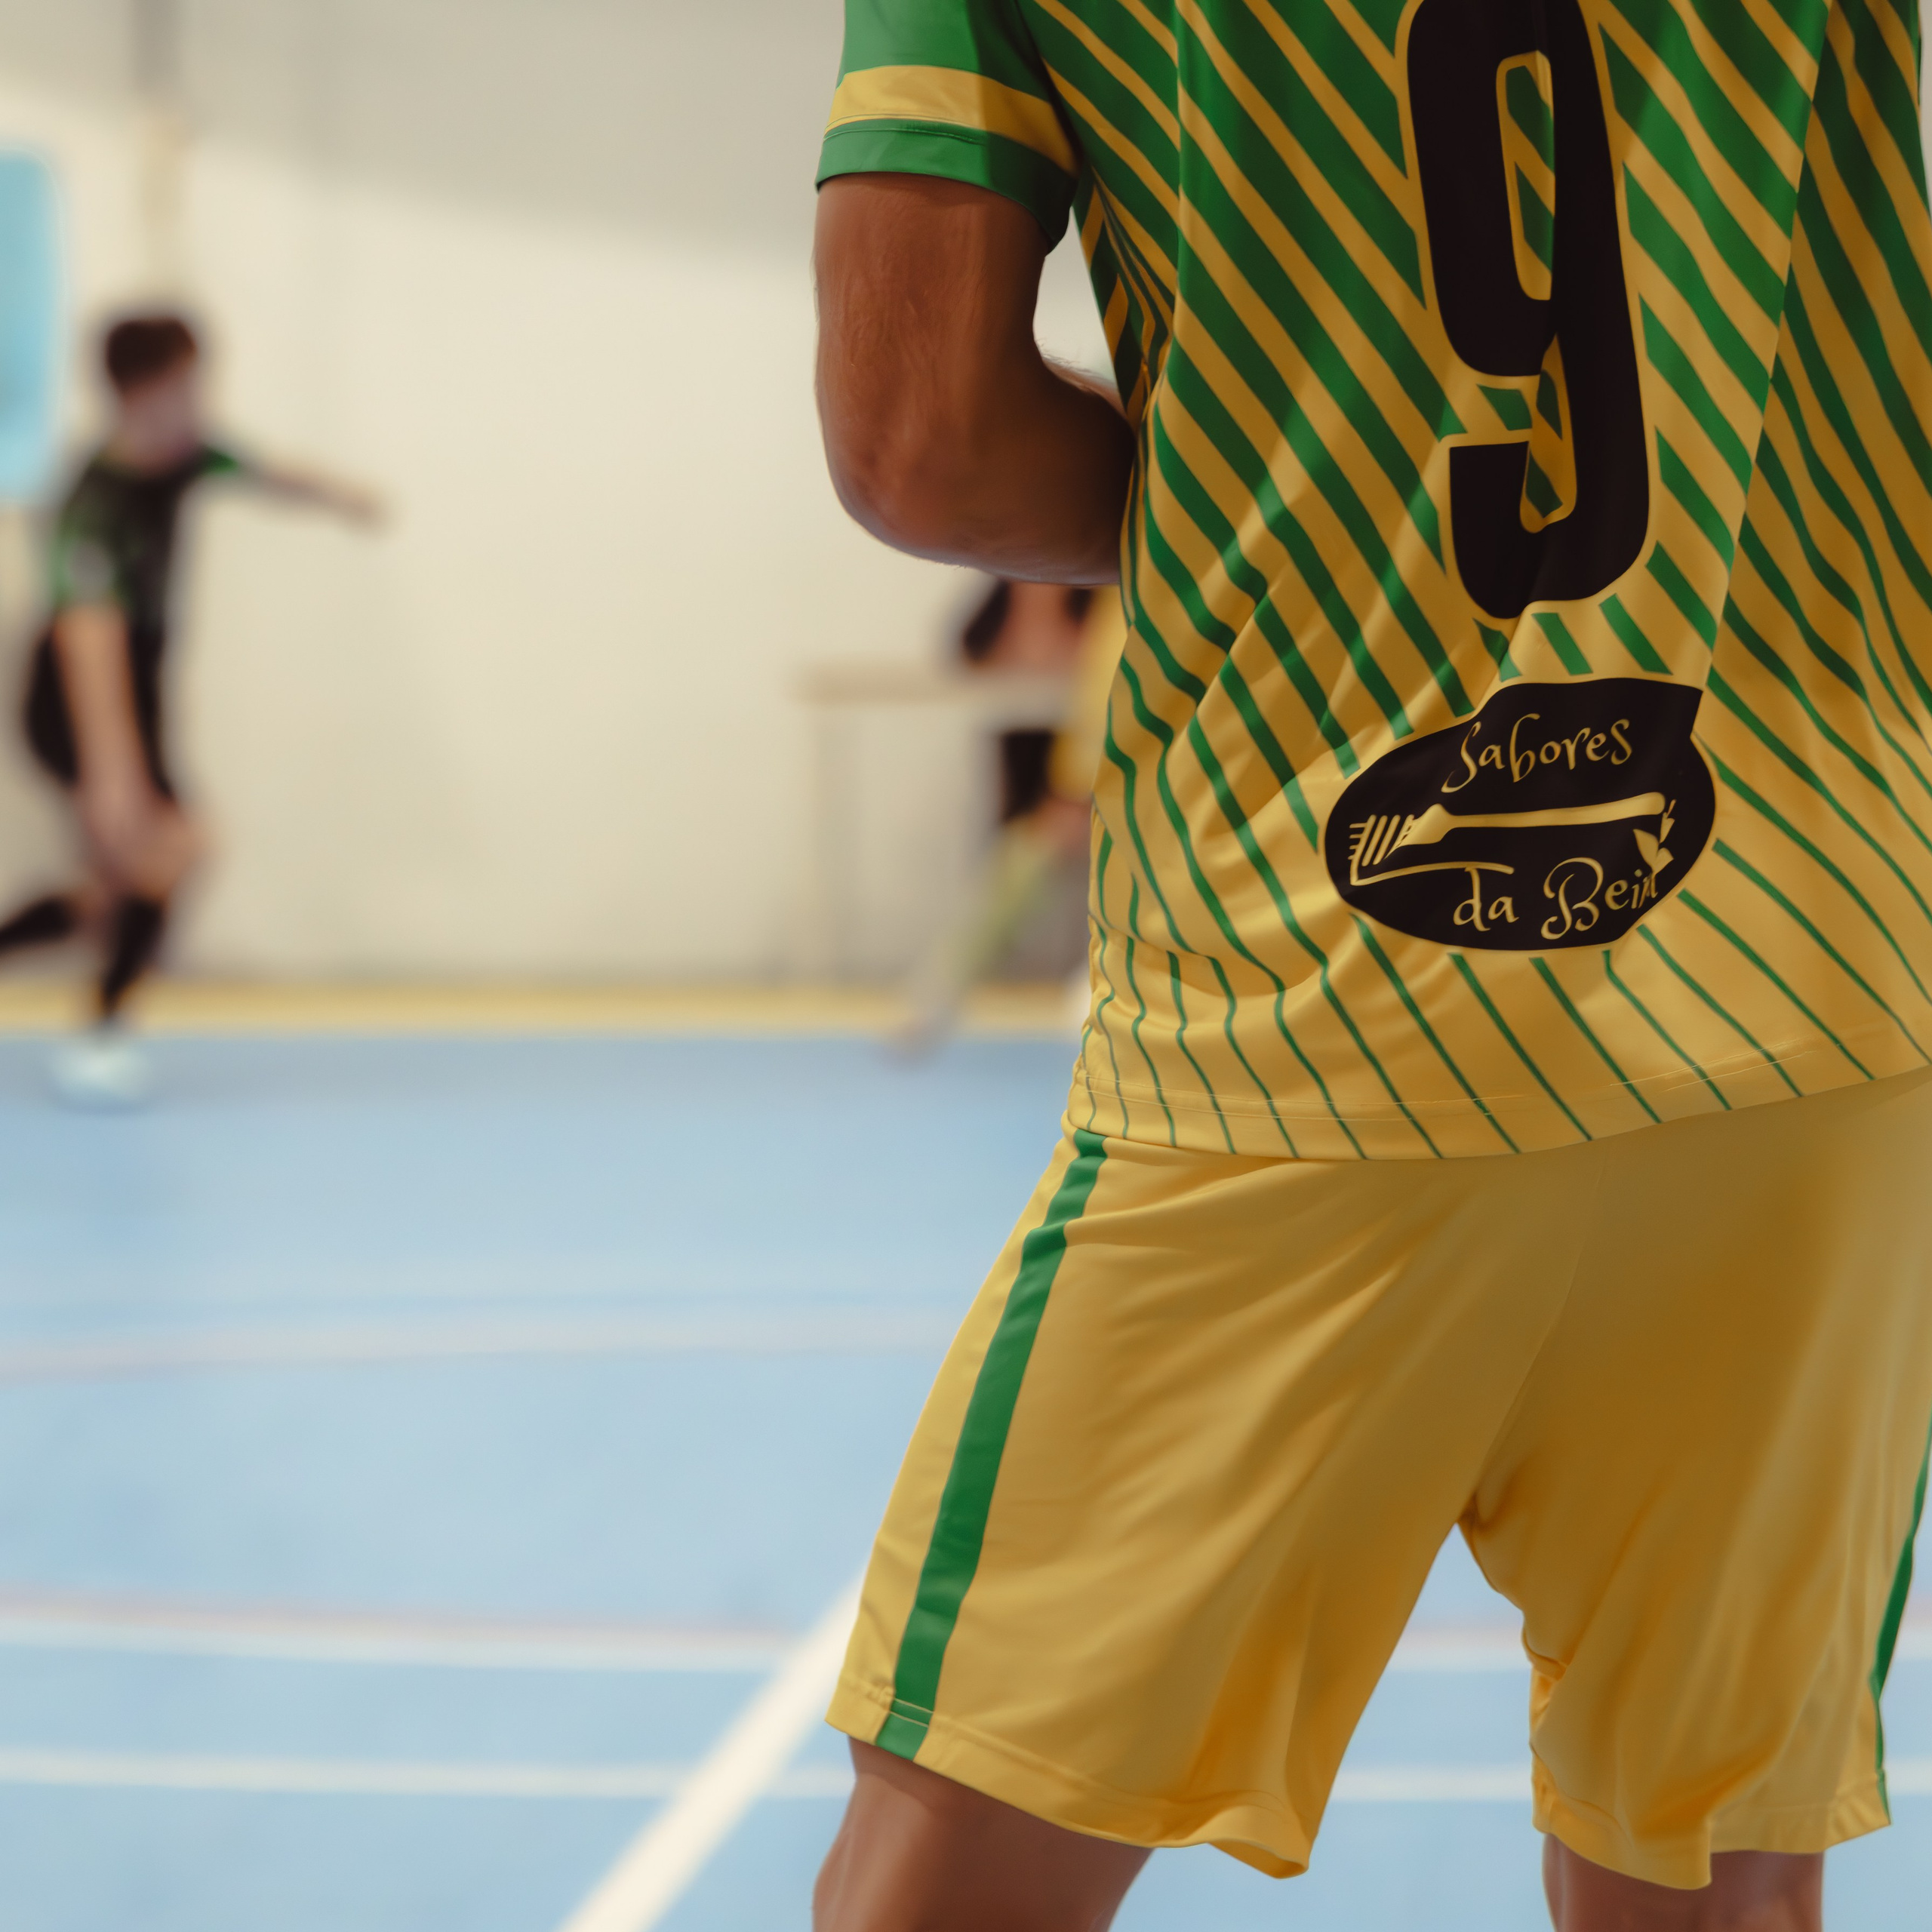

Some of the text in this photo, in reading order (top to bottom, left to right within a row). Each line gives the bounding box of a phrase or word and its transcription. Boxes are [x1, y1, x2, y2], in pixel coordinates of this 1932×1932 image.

[1407, 0, 1650, 620] 9
[1441, 712, 1632, 793] Sabores
[1453, 866, 1520, 932] da
